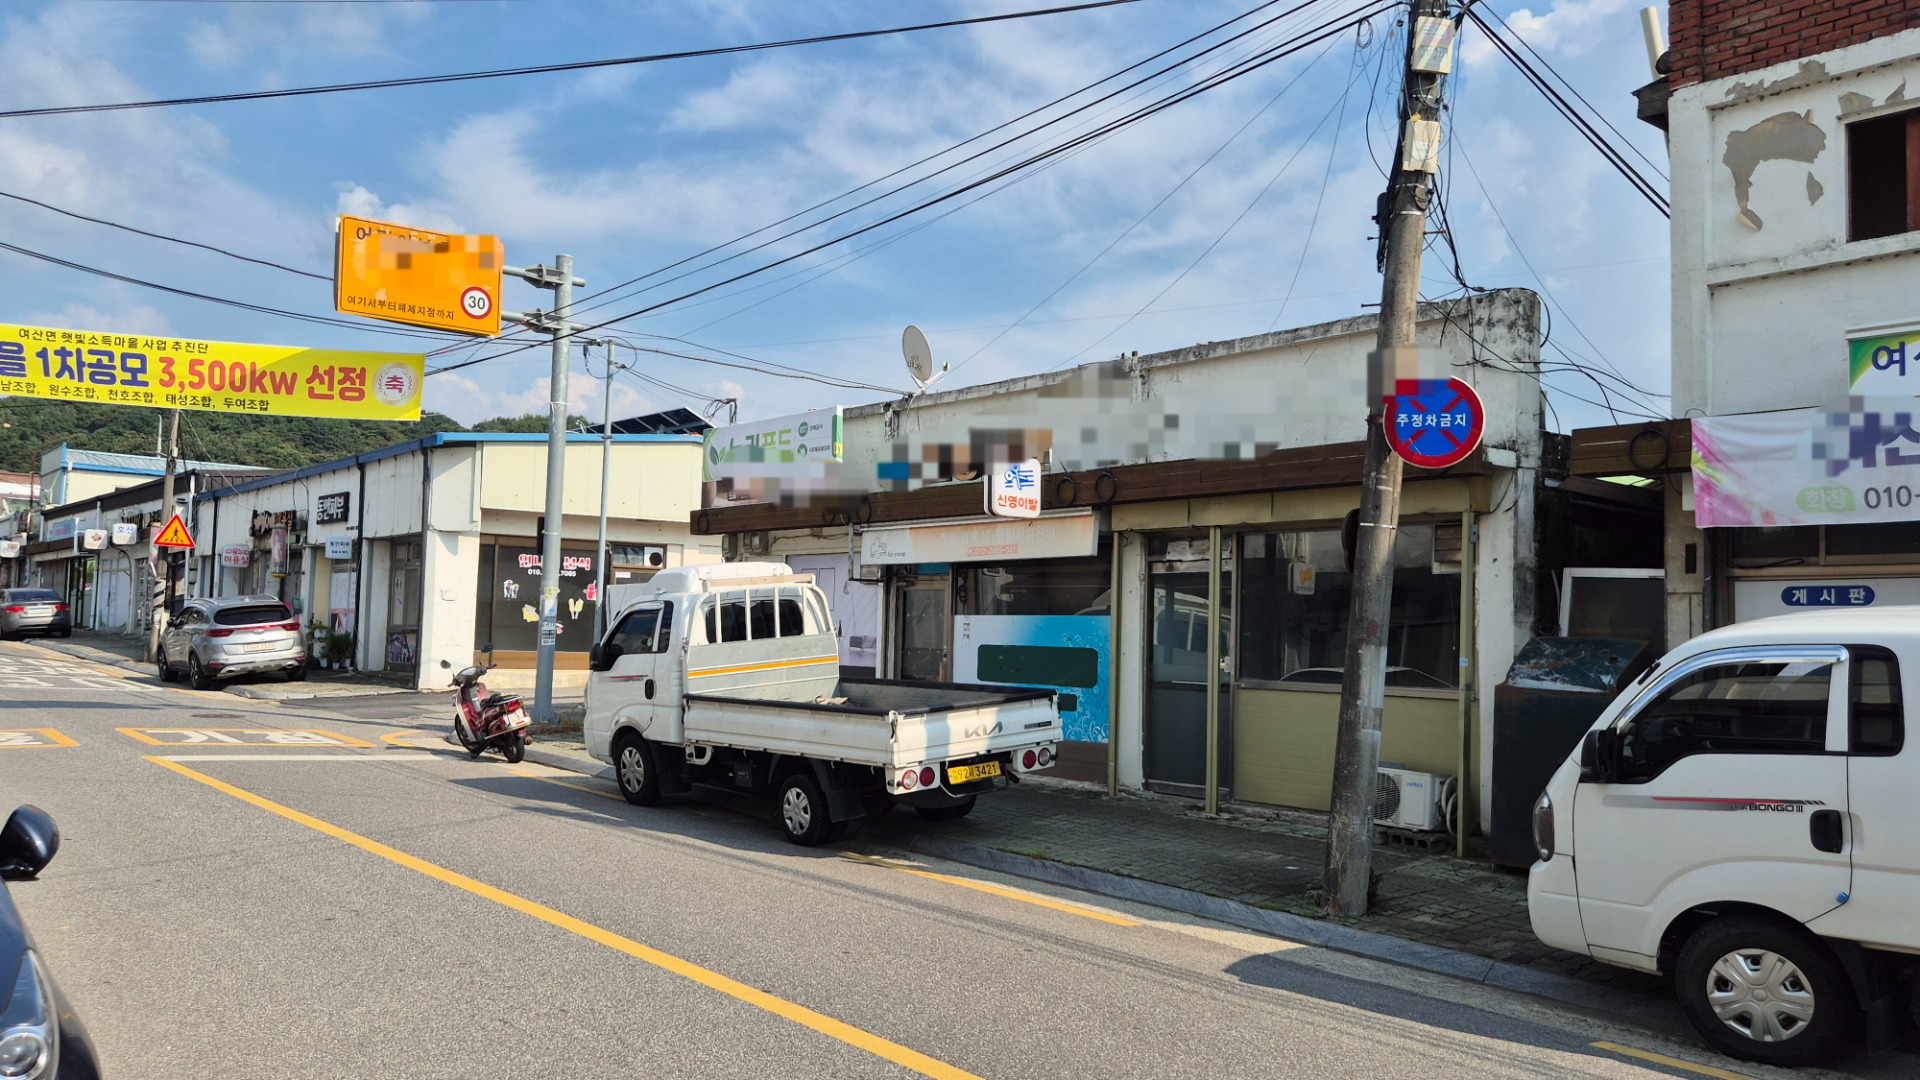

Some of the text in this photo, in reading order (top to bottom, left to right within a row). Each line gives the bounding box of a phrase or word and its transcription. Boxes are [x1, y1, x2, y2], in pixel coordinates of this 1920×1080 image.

[468, 296, 486, 310] 30
[19, 328, 209, 354] 여산면 햇빛소득마을 사업 추진단
[36, 346, 150, 388] 1차공모
[158, 356, 299, 396] 3,500kw
[305, 365, 367, 402] 선정
[385, 374, 405, 393] 축
[49, 383, 100, 400] 원수조합,
[108, 389, 158, 404] 천호조합,
[165, 394, 216, 409] 태성조합,
[223, 397, 271, 412] 두여조합
[1396, 413, 1467, 428] 주정차금지
[997, 494, 1038, 512] 신영이발
[1803, 487, 1848, 511] 회장
[562, 556, 591, 571] 분식
[1749, 803, 1794, 812] BONGO
